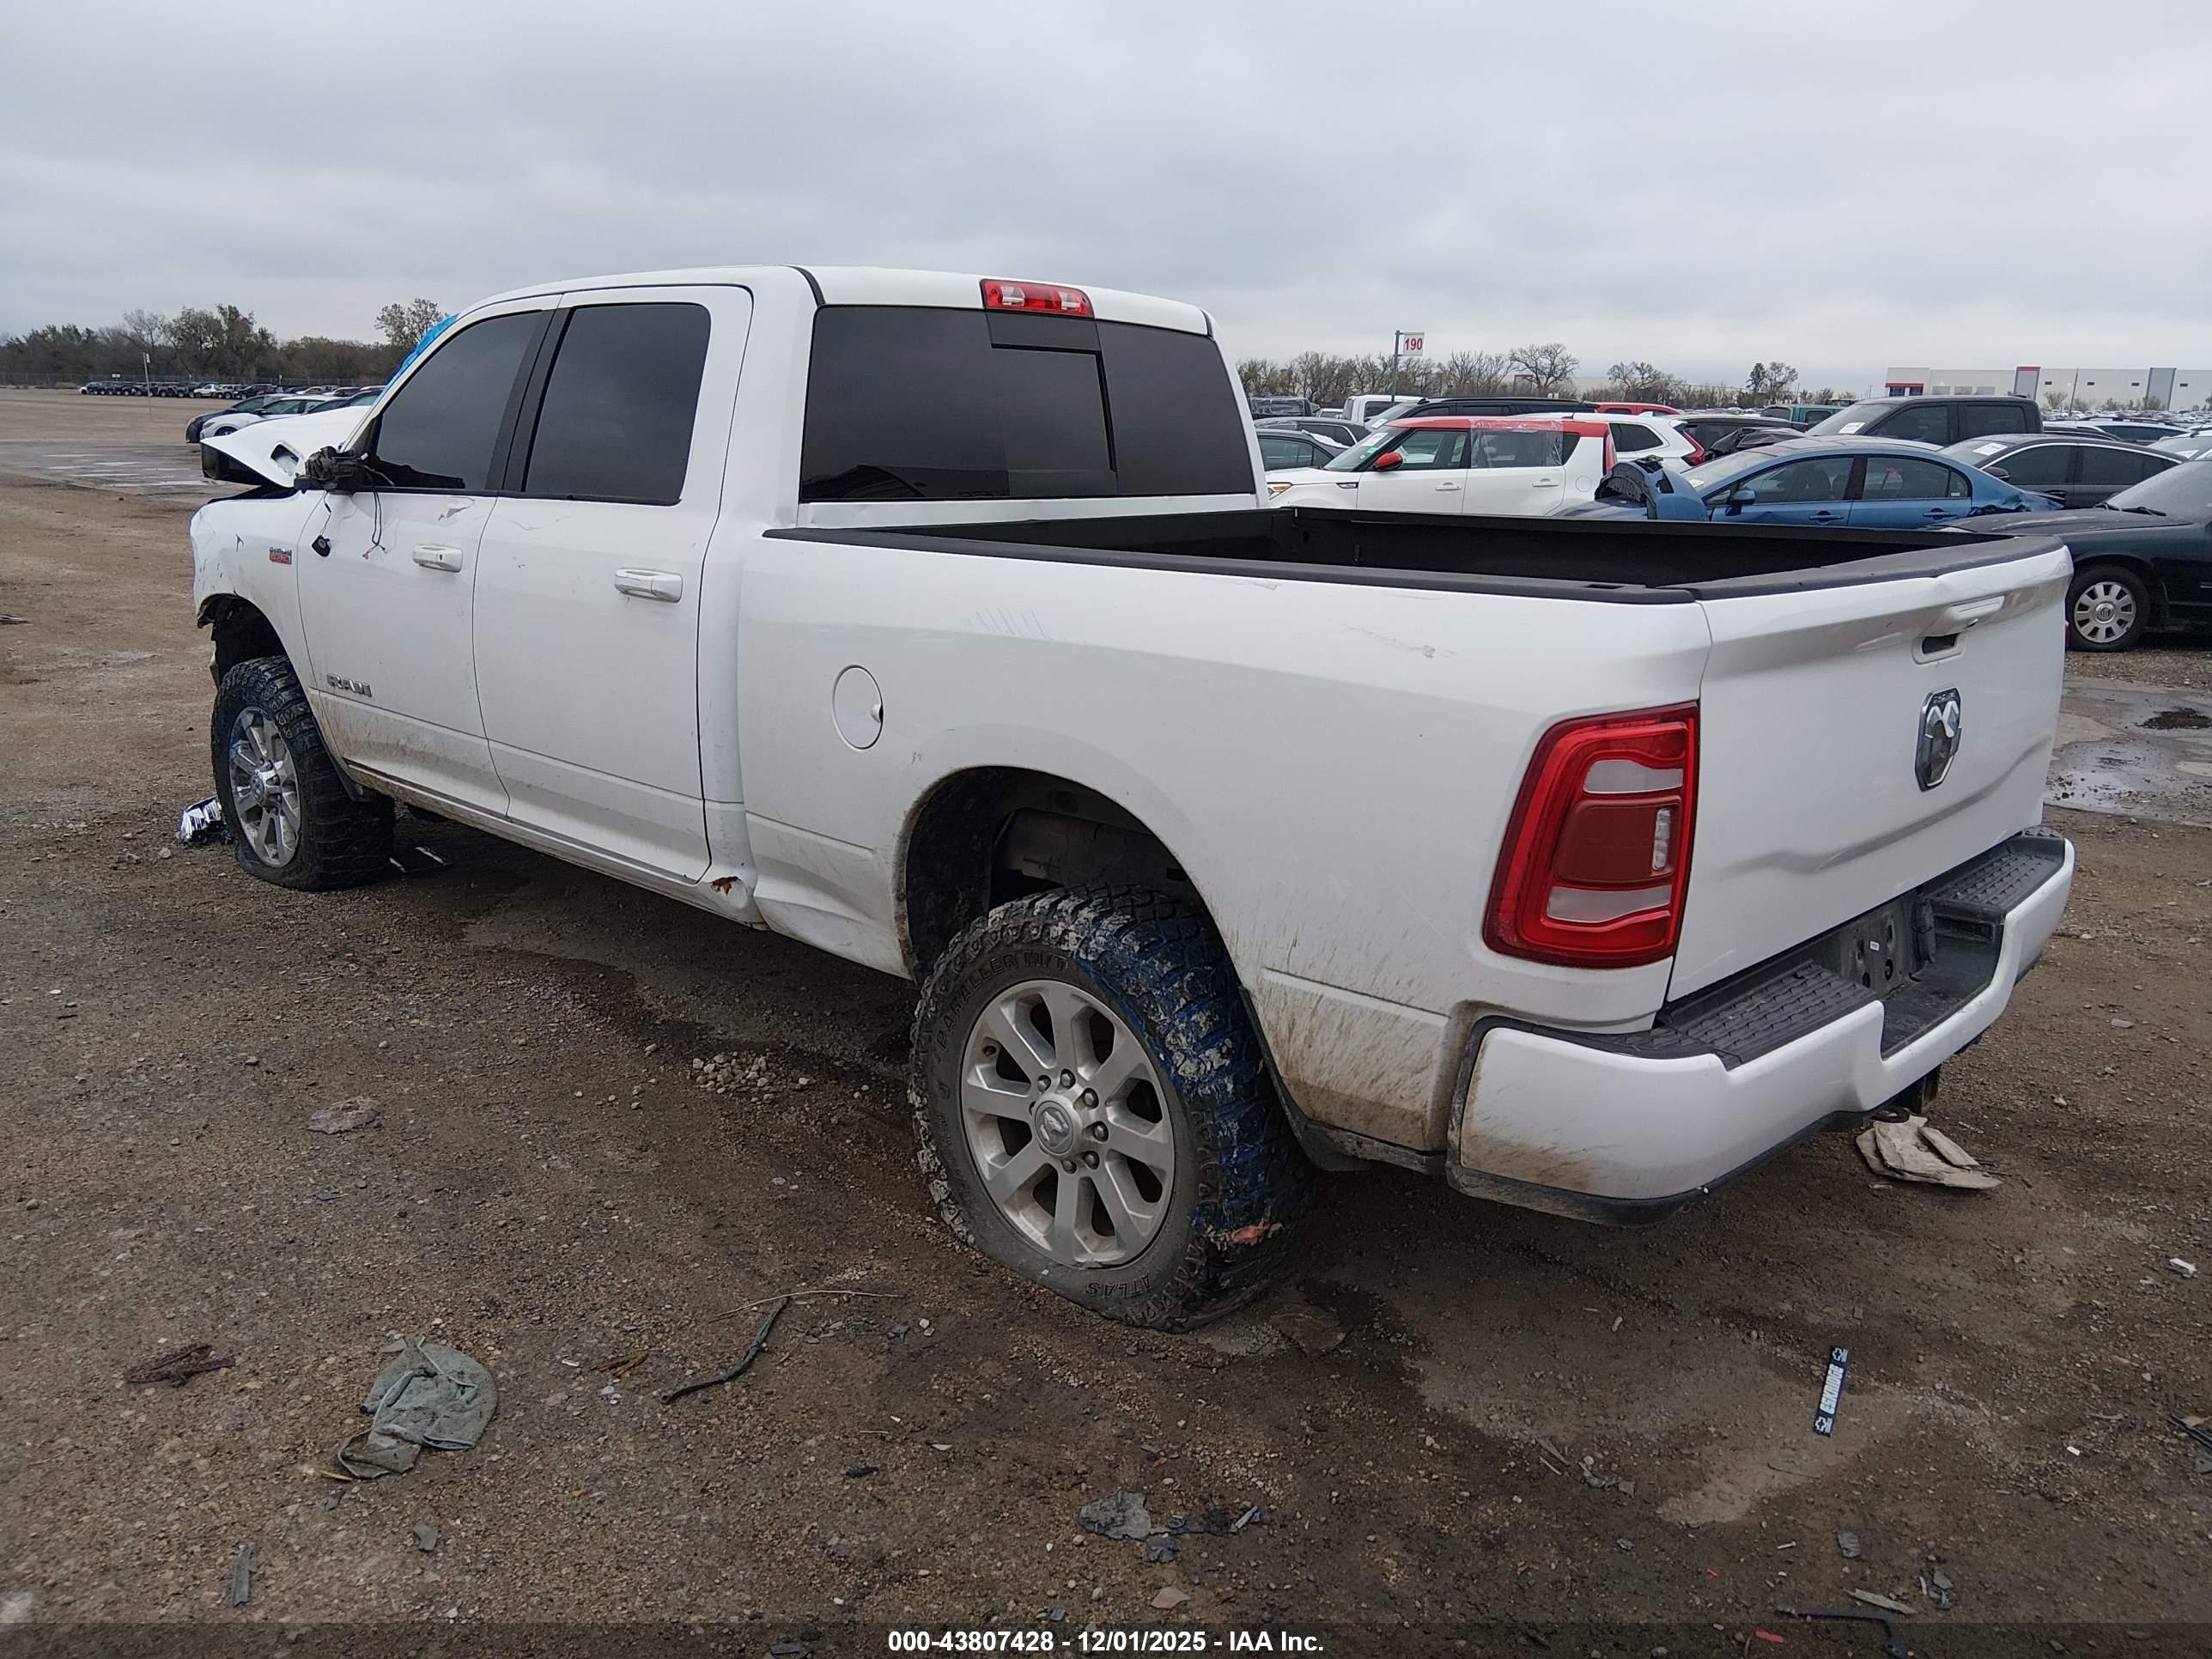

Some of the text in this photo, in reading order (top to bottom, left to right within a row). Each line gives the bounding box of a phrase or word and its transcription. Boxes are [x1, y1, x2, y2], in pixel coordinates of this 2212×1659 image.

[1404, 337, 1423, 350] 190
[326, 673, 372, 697] RAM
[936, 953, 1018, 1050] PARALLER
[1085, 1271, 1153, 1298] ATLAS
